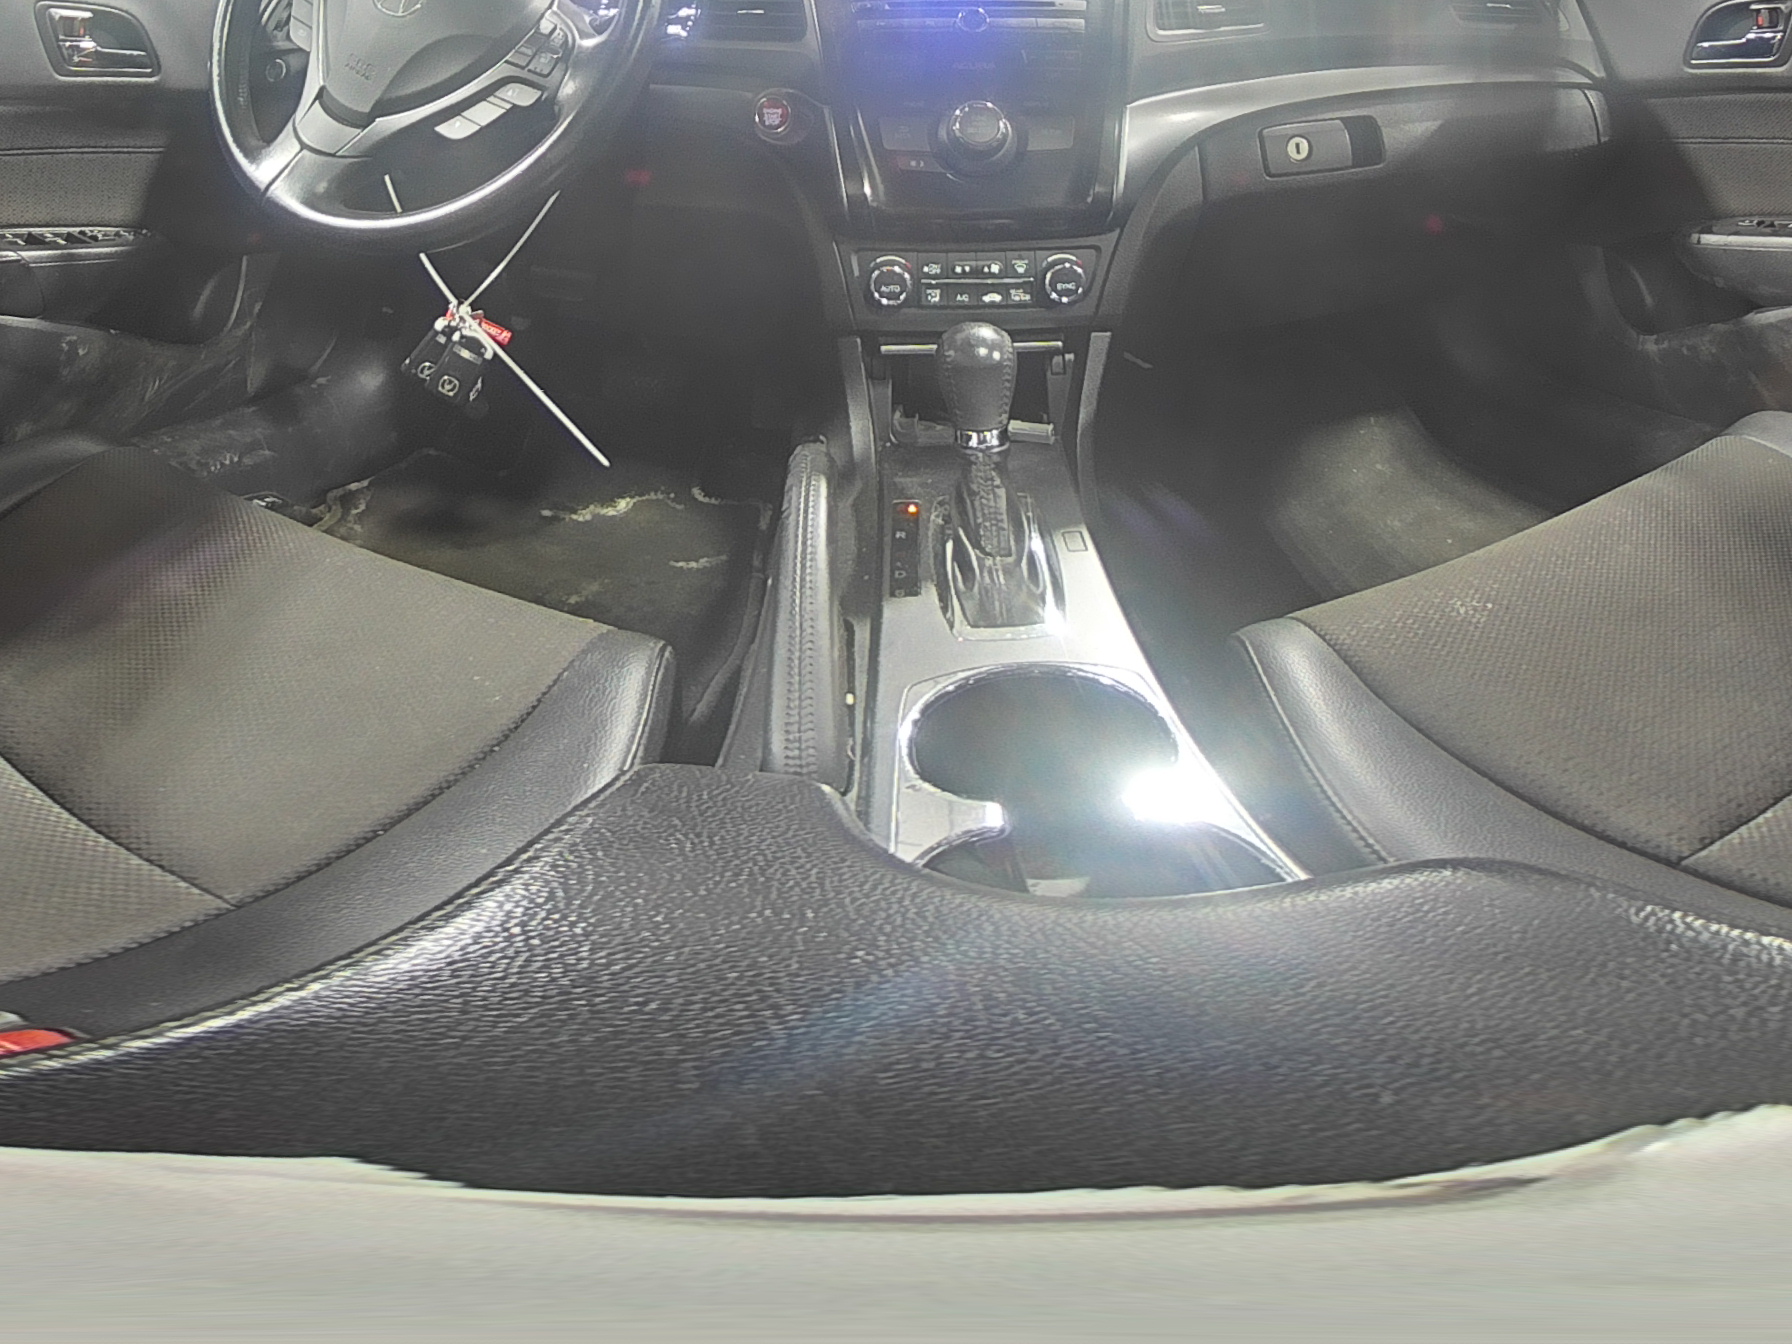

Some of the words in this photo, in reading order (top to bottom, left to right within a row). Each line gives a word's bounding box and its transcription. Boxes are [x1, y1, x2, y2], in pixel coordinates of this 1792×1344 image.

[880, 284, 901, 293] AUTO
[895, 531, 906, 539] R
[895, 570, 906, 578] D
